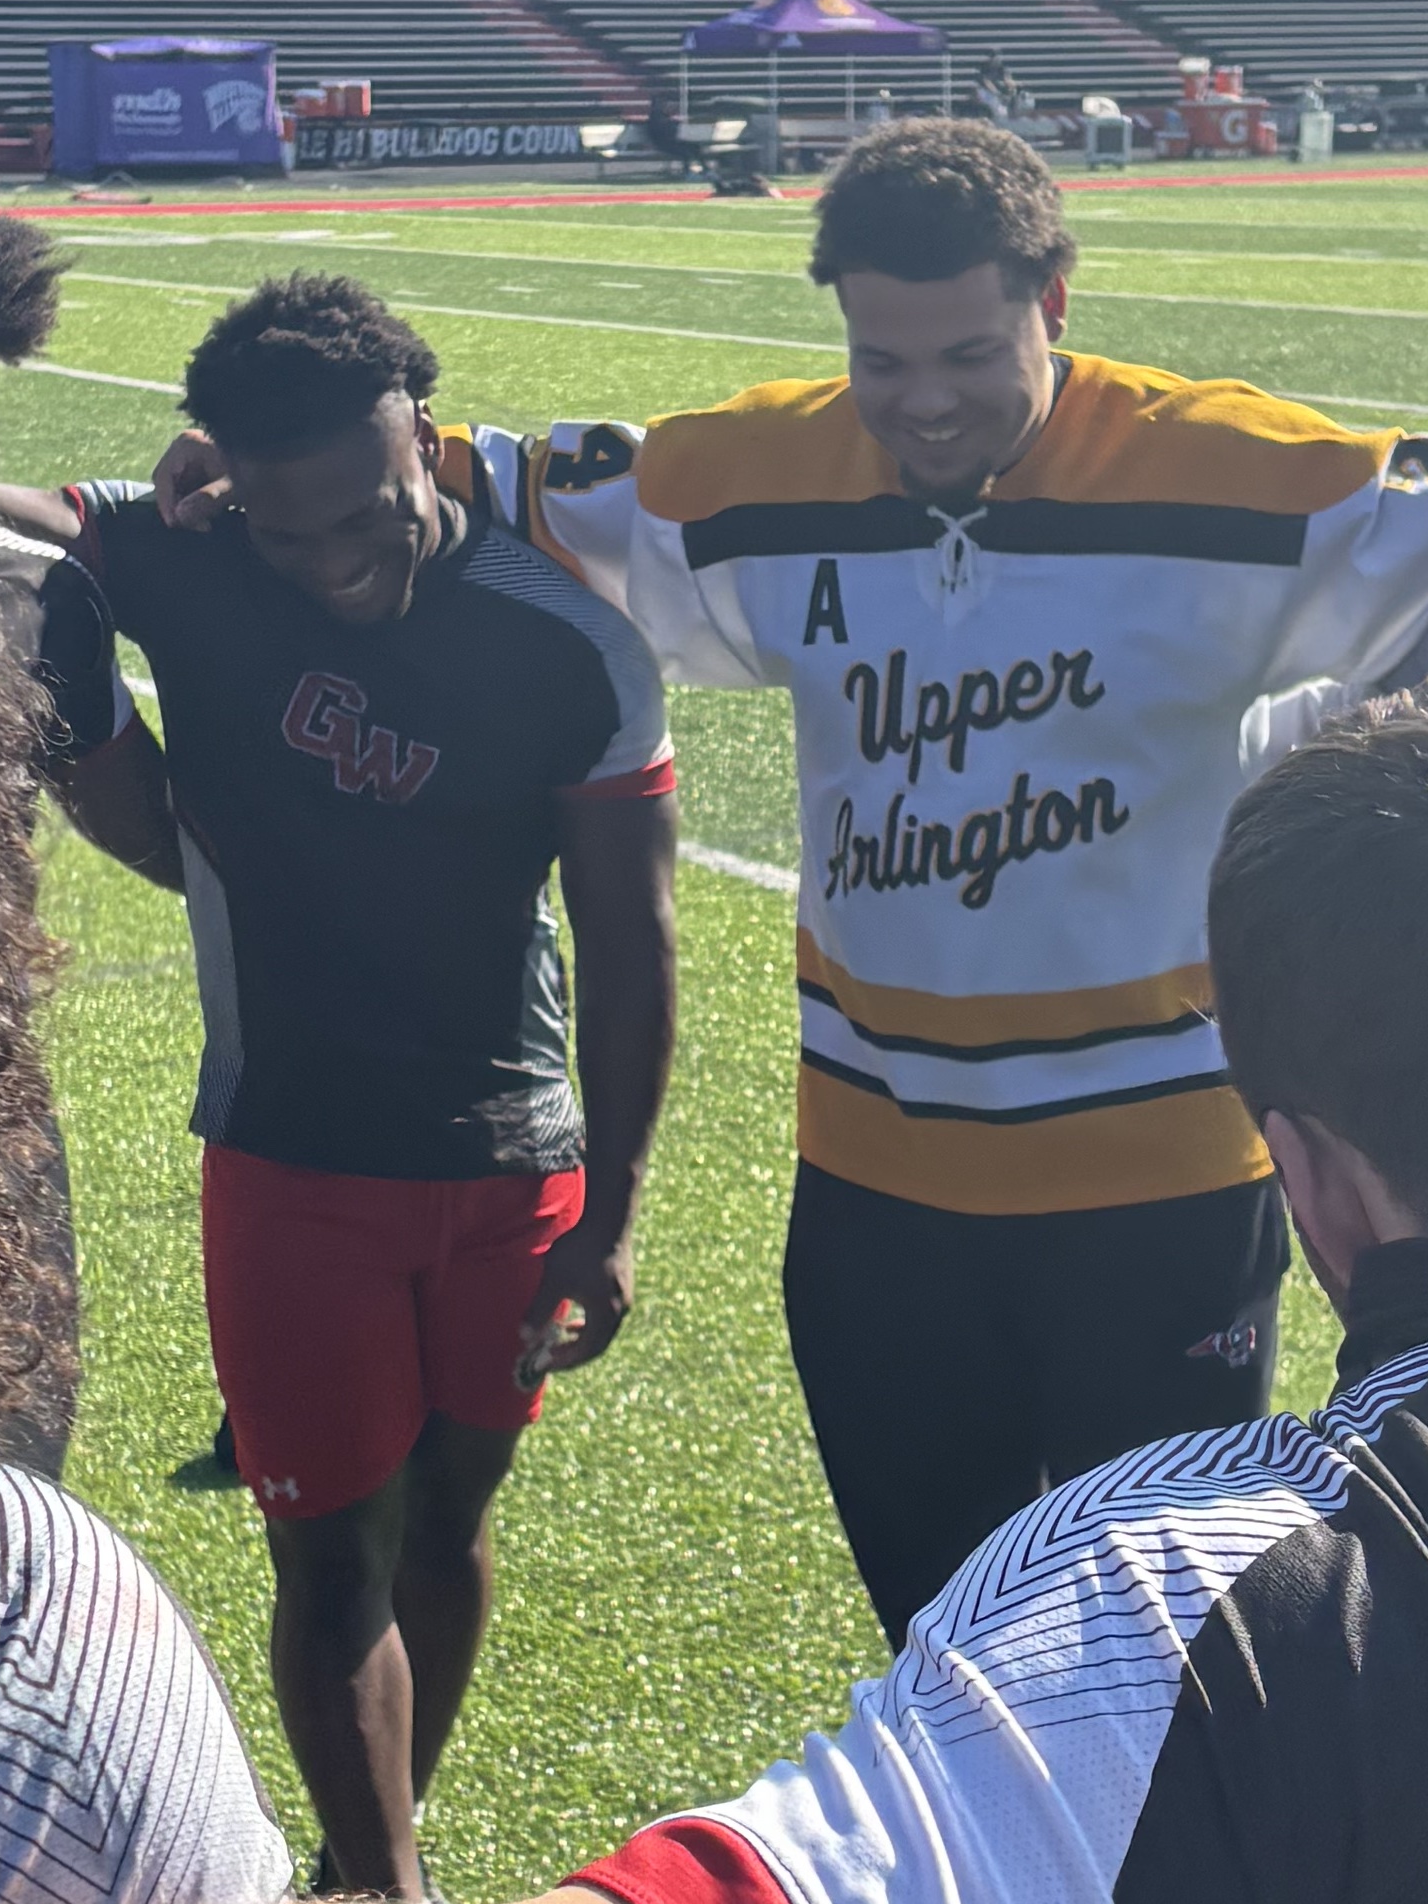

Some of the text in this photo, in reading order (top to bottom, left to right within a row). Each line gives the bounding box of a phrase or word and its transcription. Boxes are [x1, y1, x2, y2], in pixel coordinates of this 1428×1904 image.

[1222, 108, 1250, 144] G
[802, 558, 849, 645] A
[280, 670, 440, 803] GW
[843, 647, 1107, 785] Upper
[822, 772, 1131, 911] Arlington
